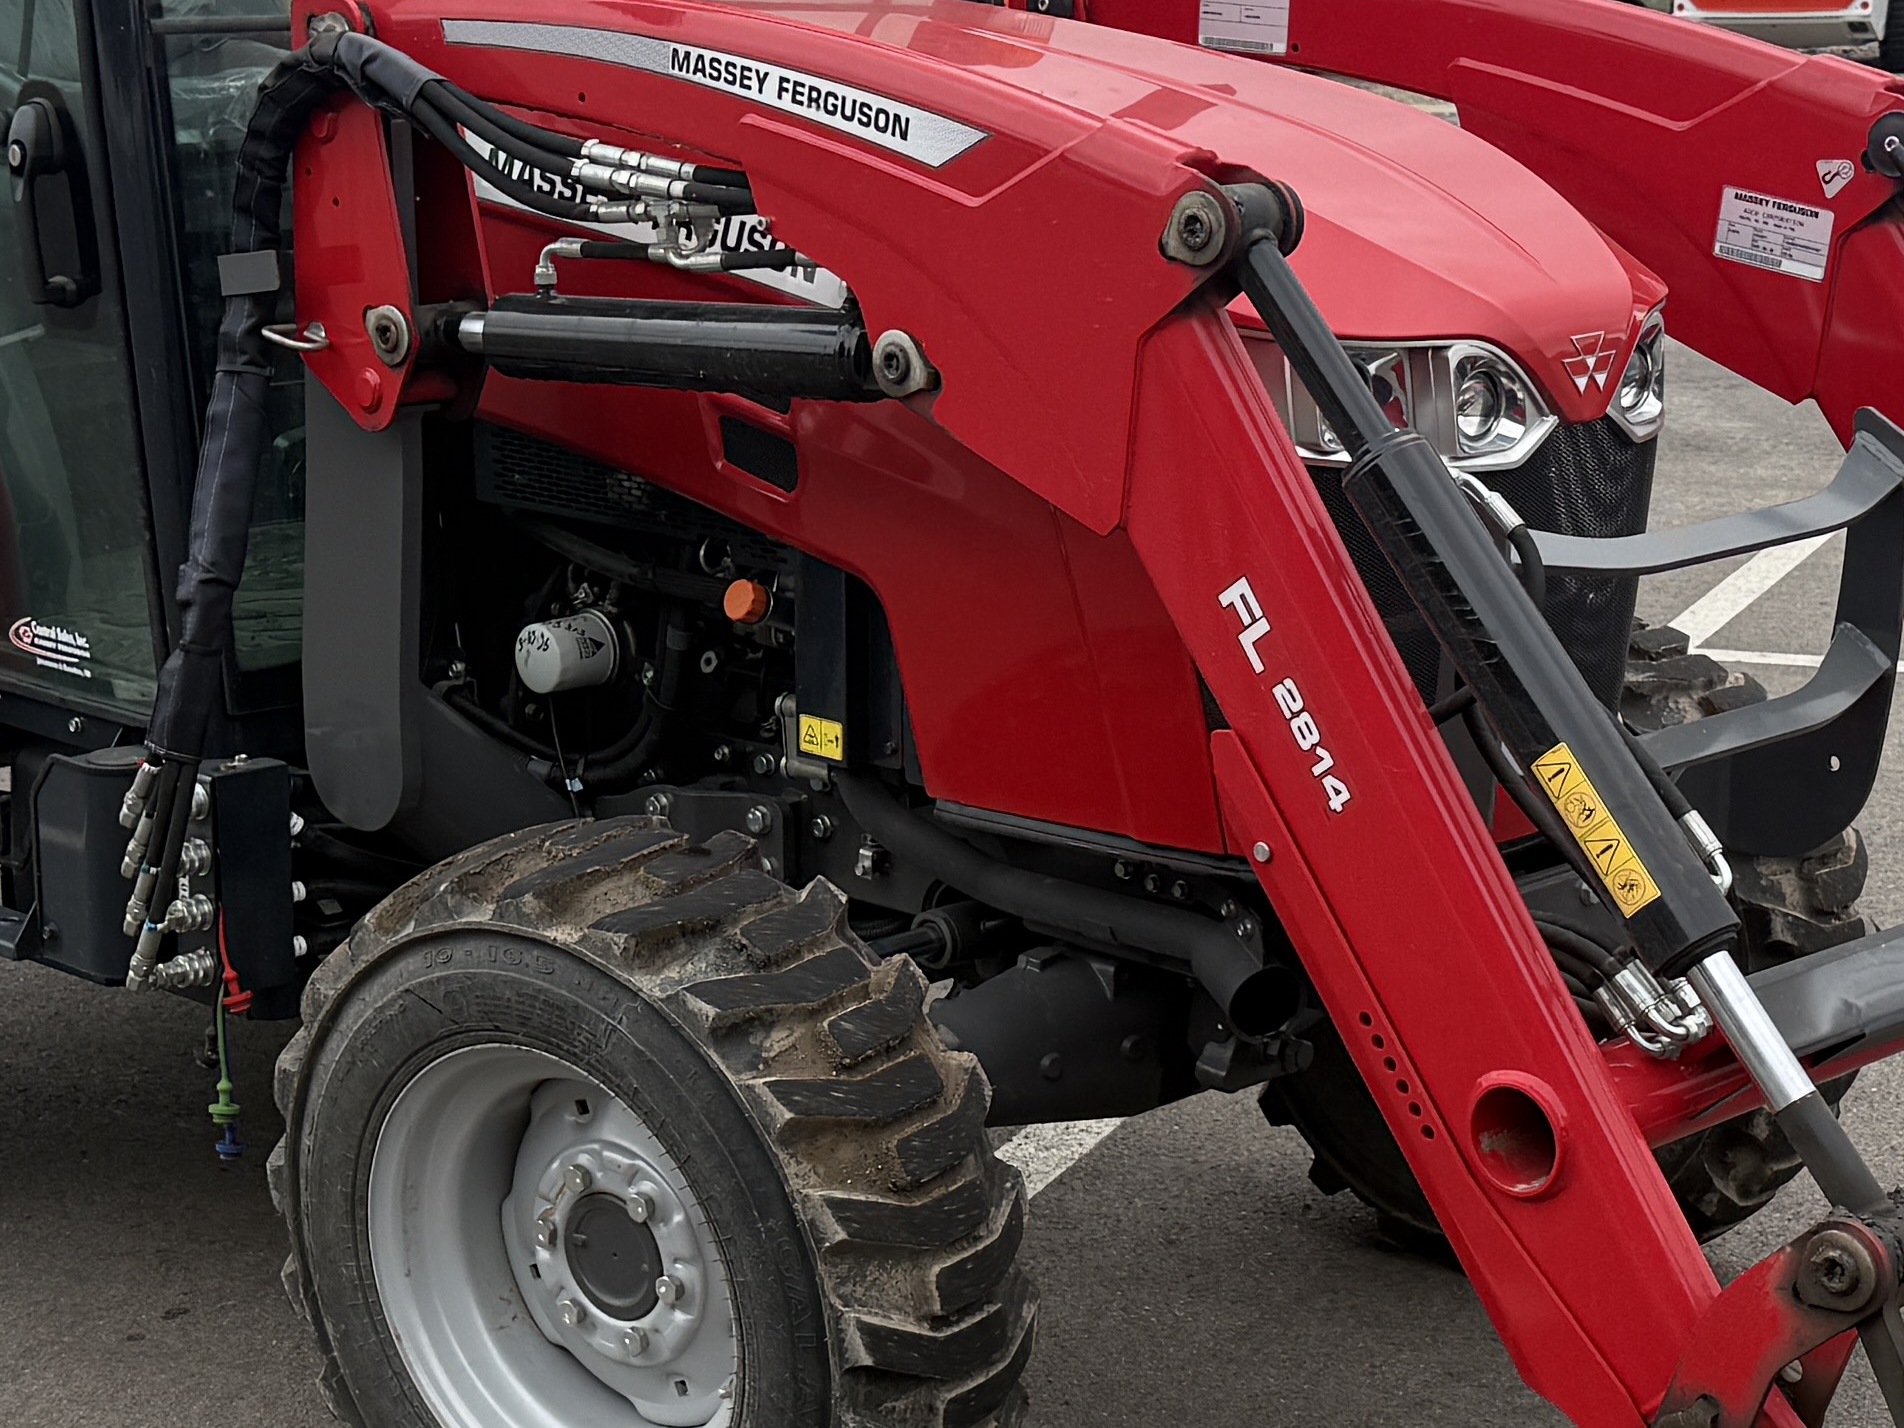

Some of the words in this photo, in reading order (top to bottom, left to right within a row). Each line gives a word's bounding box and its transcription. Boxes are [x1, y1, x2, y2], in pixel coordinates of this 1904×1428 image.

[669, 47, 770, 95] MASSEY
[776, 76, 911, 142] FERGUSON
[1733, 191, 1771, 208] MASSEY
[1771, 200, 1820, 219] FERGUSON
[1217, 575, 1272, 676] FL
[1271, 676, 1352, 814] 2814
